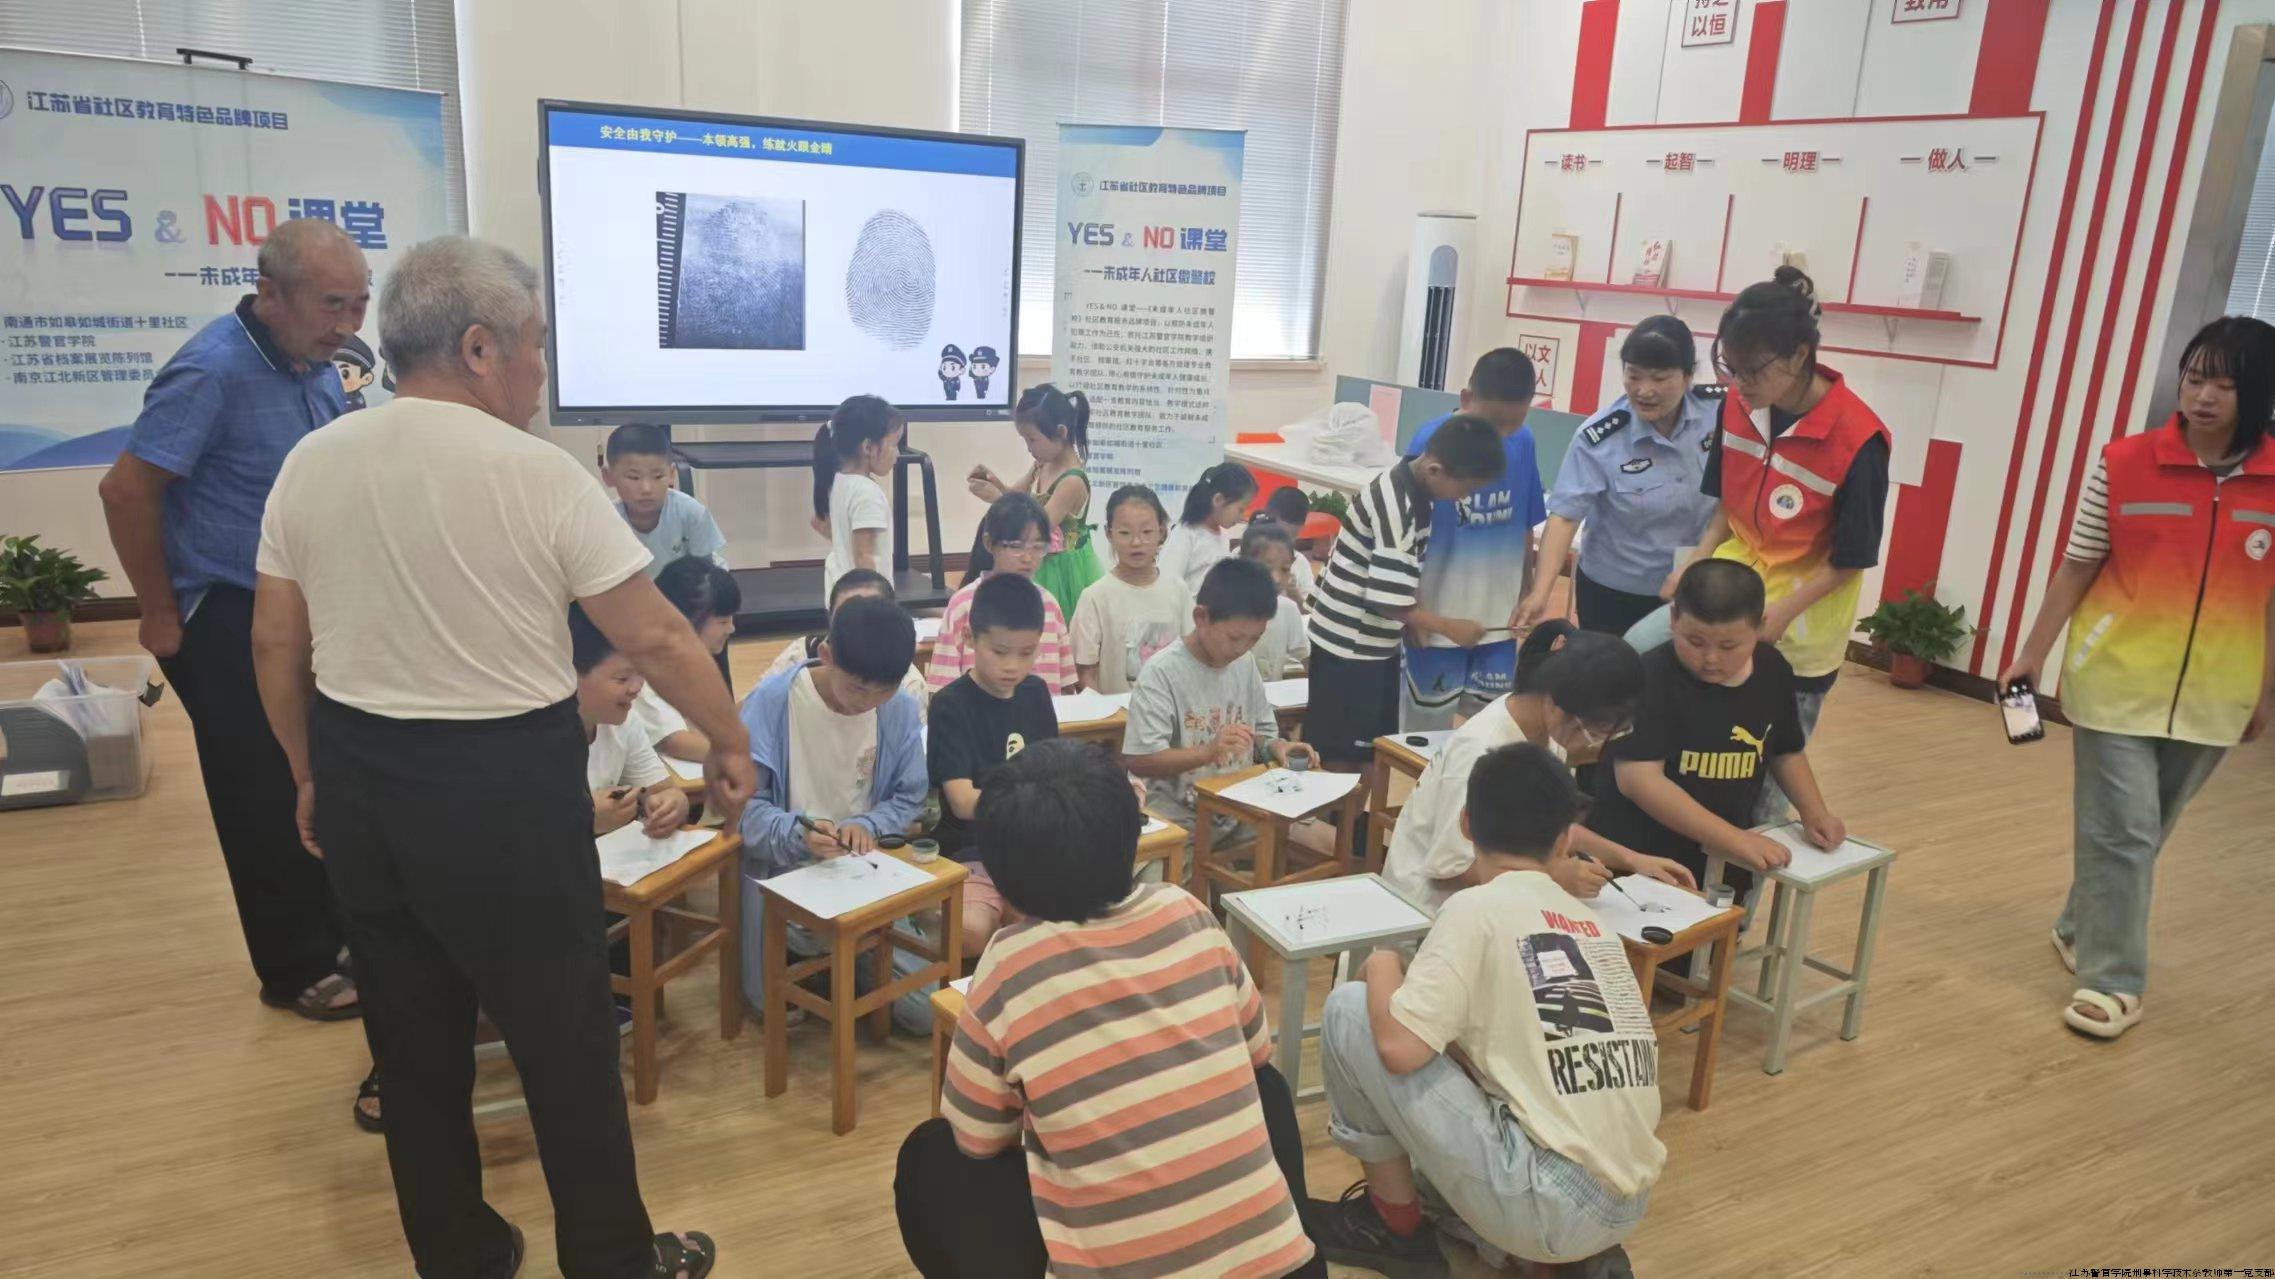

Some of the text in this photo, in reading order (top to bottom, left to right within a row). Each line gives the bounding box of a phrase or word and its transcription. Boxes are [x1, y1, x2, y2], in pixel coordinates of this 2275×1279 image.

[1691, 14, 1727, 37] 以恒
[27, 91, 289, 131] 江苏省社区教育特色品牌项目
[1560, 153, 1586, 171] 读书
[1664, 151, 1695, 172] 起智
[1782, 151, 1818, 172] 明理
[1927, 149, 1966, 171] 做人
[1100, 180, 1227, 197] 江苏省社区教育特色品牌项目
[0, 184, 132, 242] YES
[154, 210, 187, 244] &
[203, 193, 276, 245] NO
[1068, 222, 1227, 252] YES & NO 课堂
[1525, 343, 1551, 363] 以文
[13, 369, 157, 384] 南京江北新区管理委员
[1679, 750, 1756, 779] PUMA
